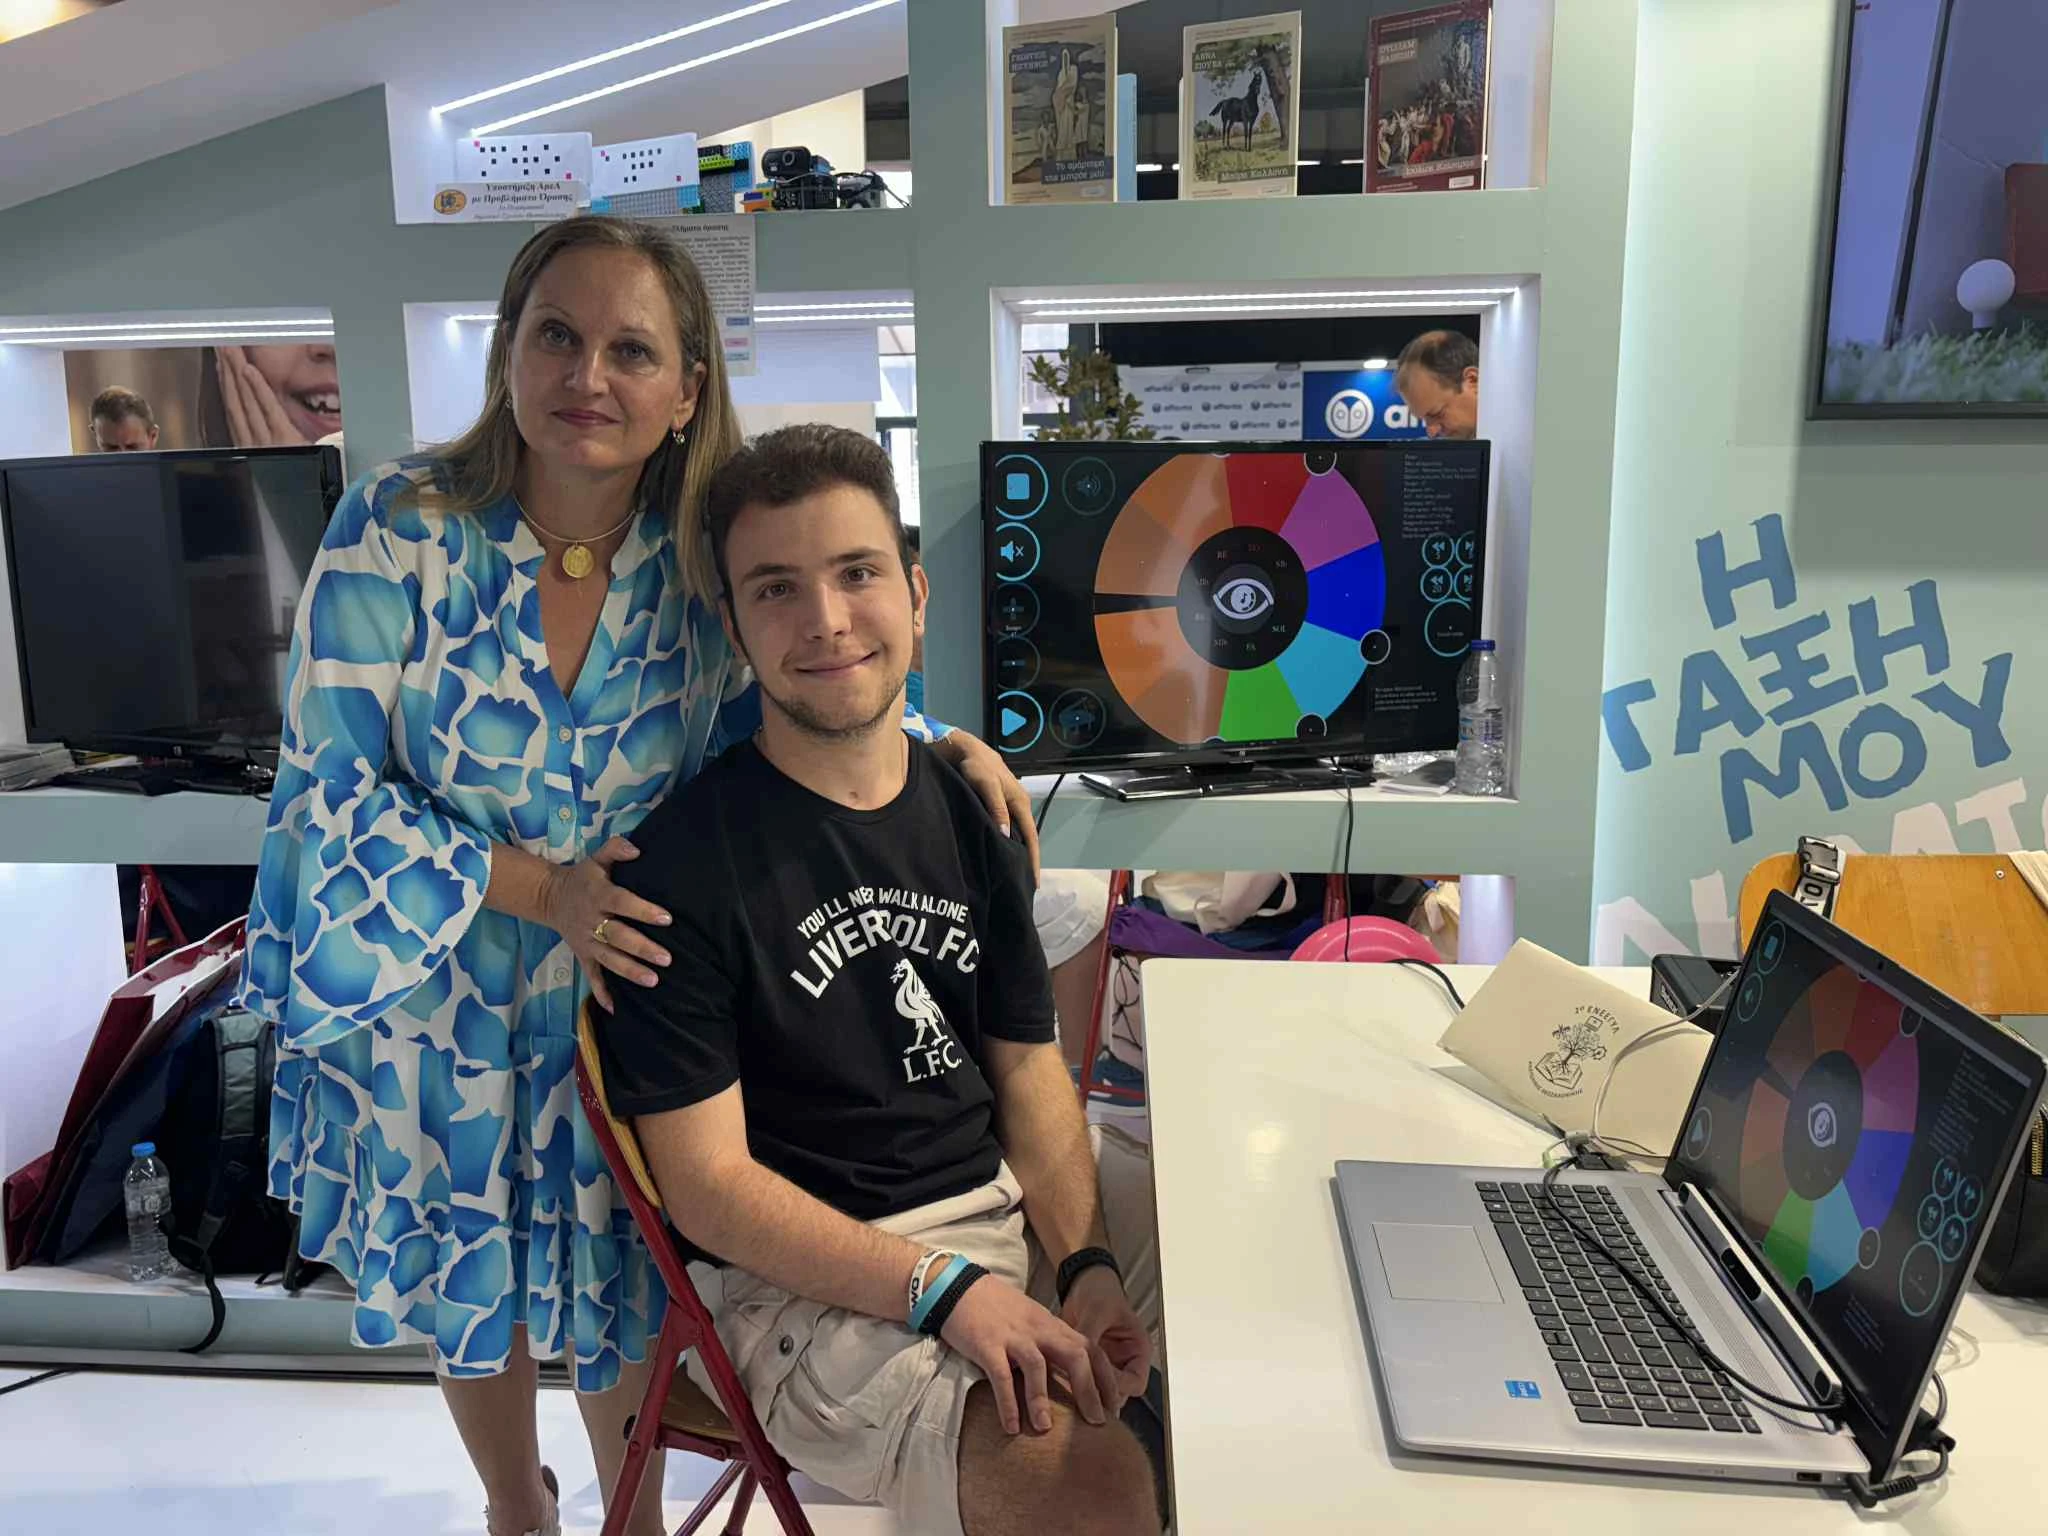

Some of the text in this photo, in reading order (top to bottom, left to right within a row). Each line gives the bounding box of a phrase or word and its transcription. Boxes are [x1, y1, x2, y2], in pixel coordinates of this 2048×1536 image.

[1695, 513, 1798, 631] Η
[1719, 652, 2014, 845] ΜΟΥ
[878, 887, 919, 911] WALK
[920, 894, 969, 924] ALONE
[936, 926, 981, 974] FC
